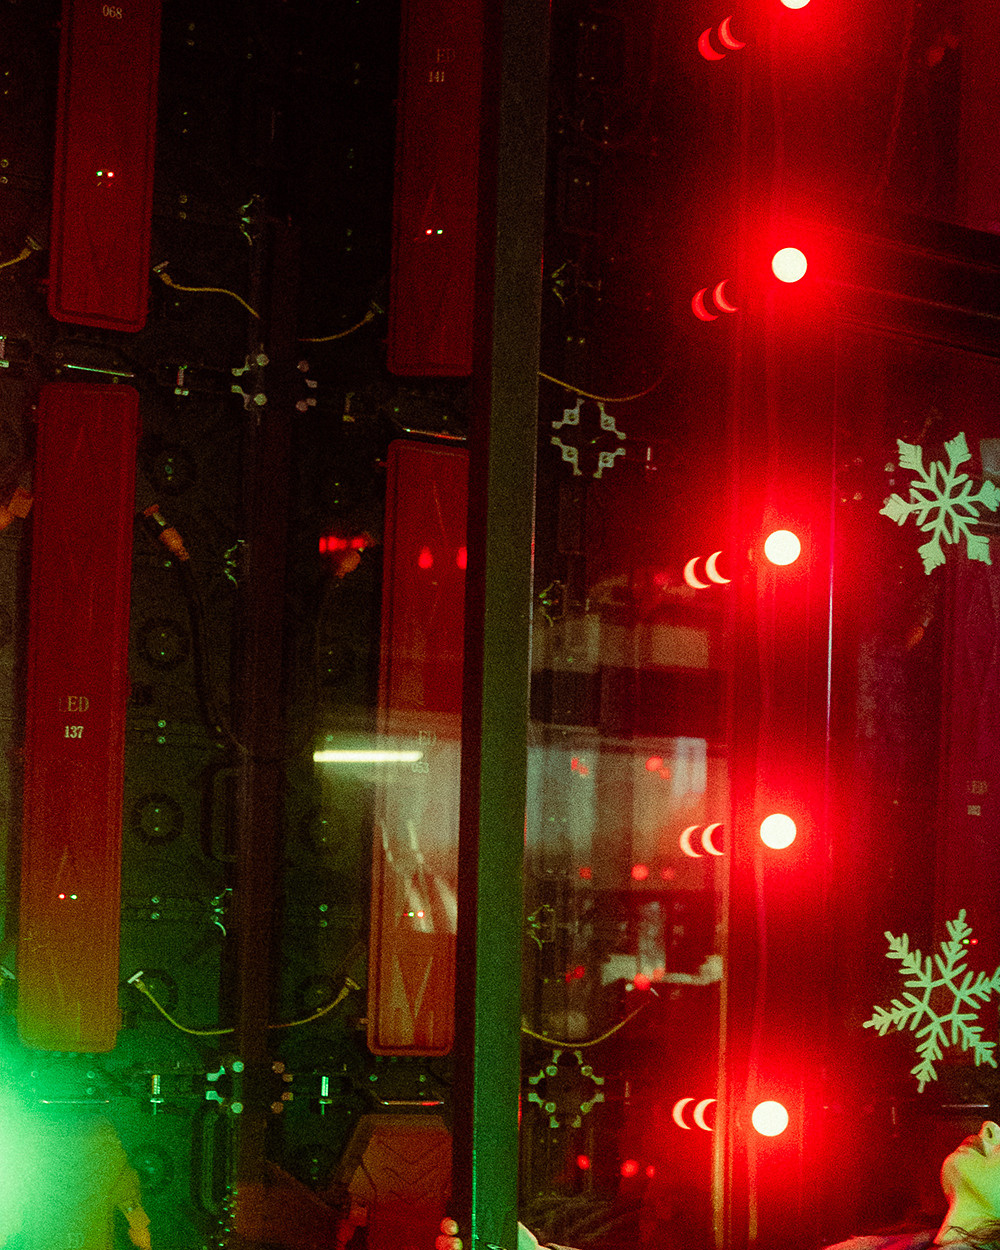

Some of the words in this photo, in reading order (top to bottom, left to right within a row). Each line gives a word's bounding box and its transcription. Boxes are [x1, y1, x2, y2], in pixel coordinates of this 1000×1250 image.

[102, 5, 123, 20] 068
[428, 71, 445, 83] 141
[64, 725, 84, 738] 137
